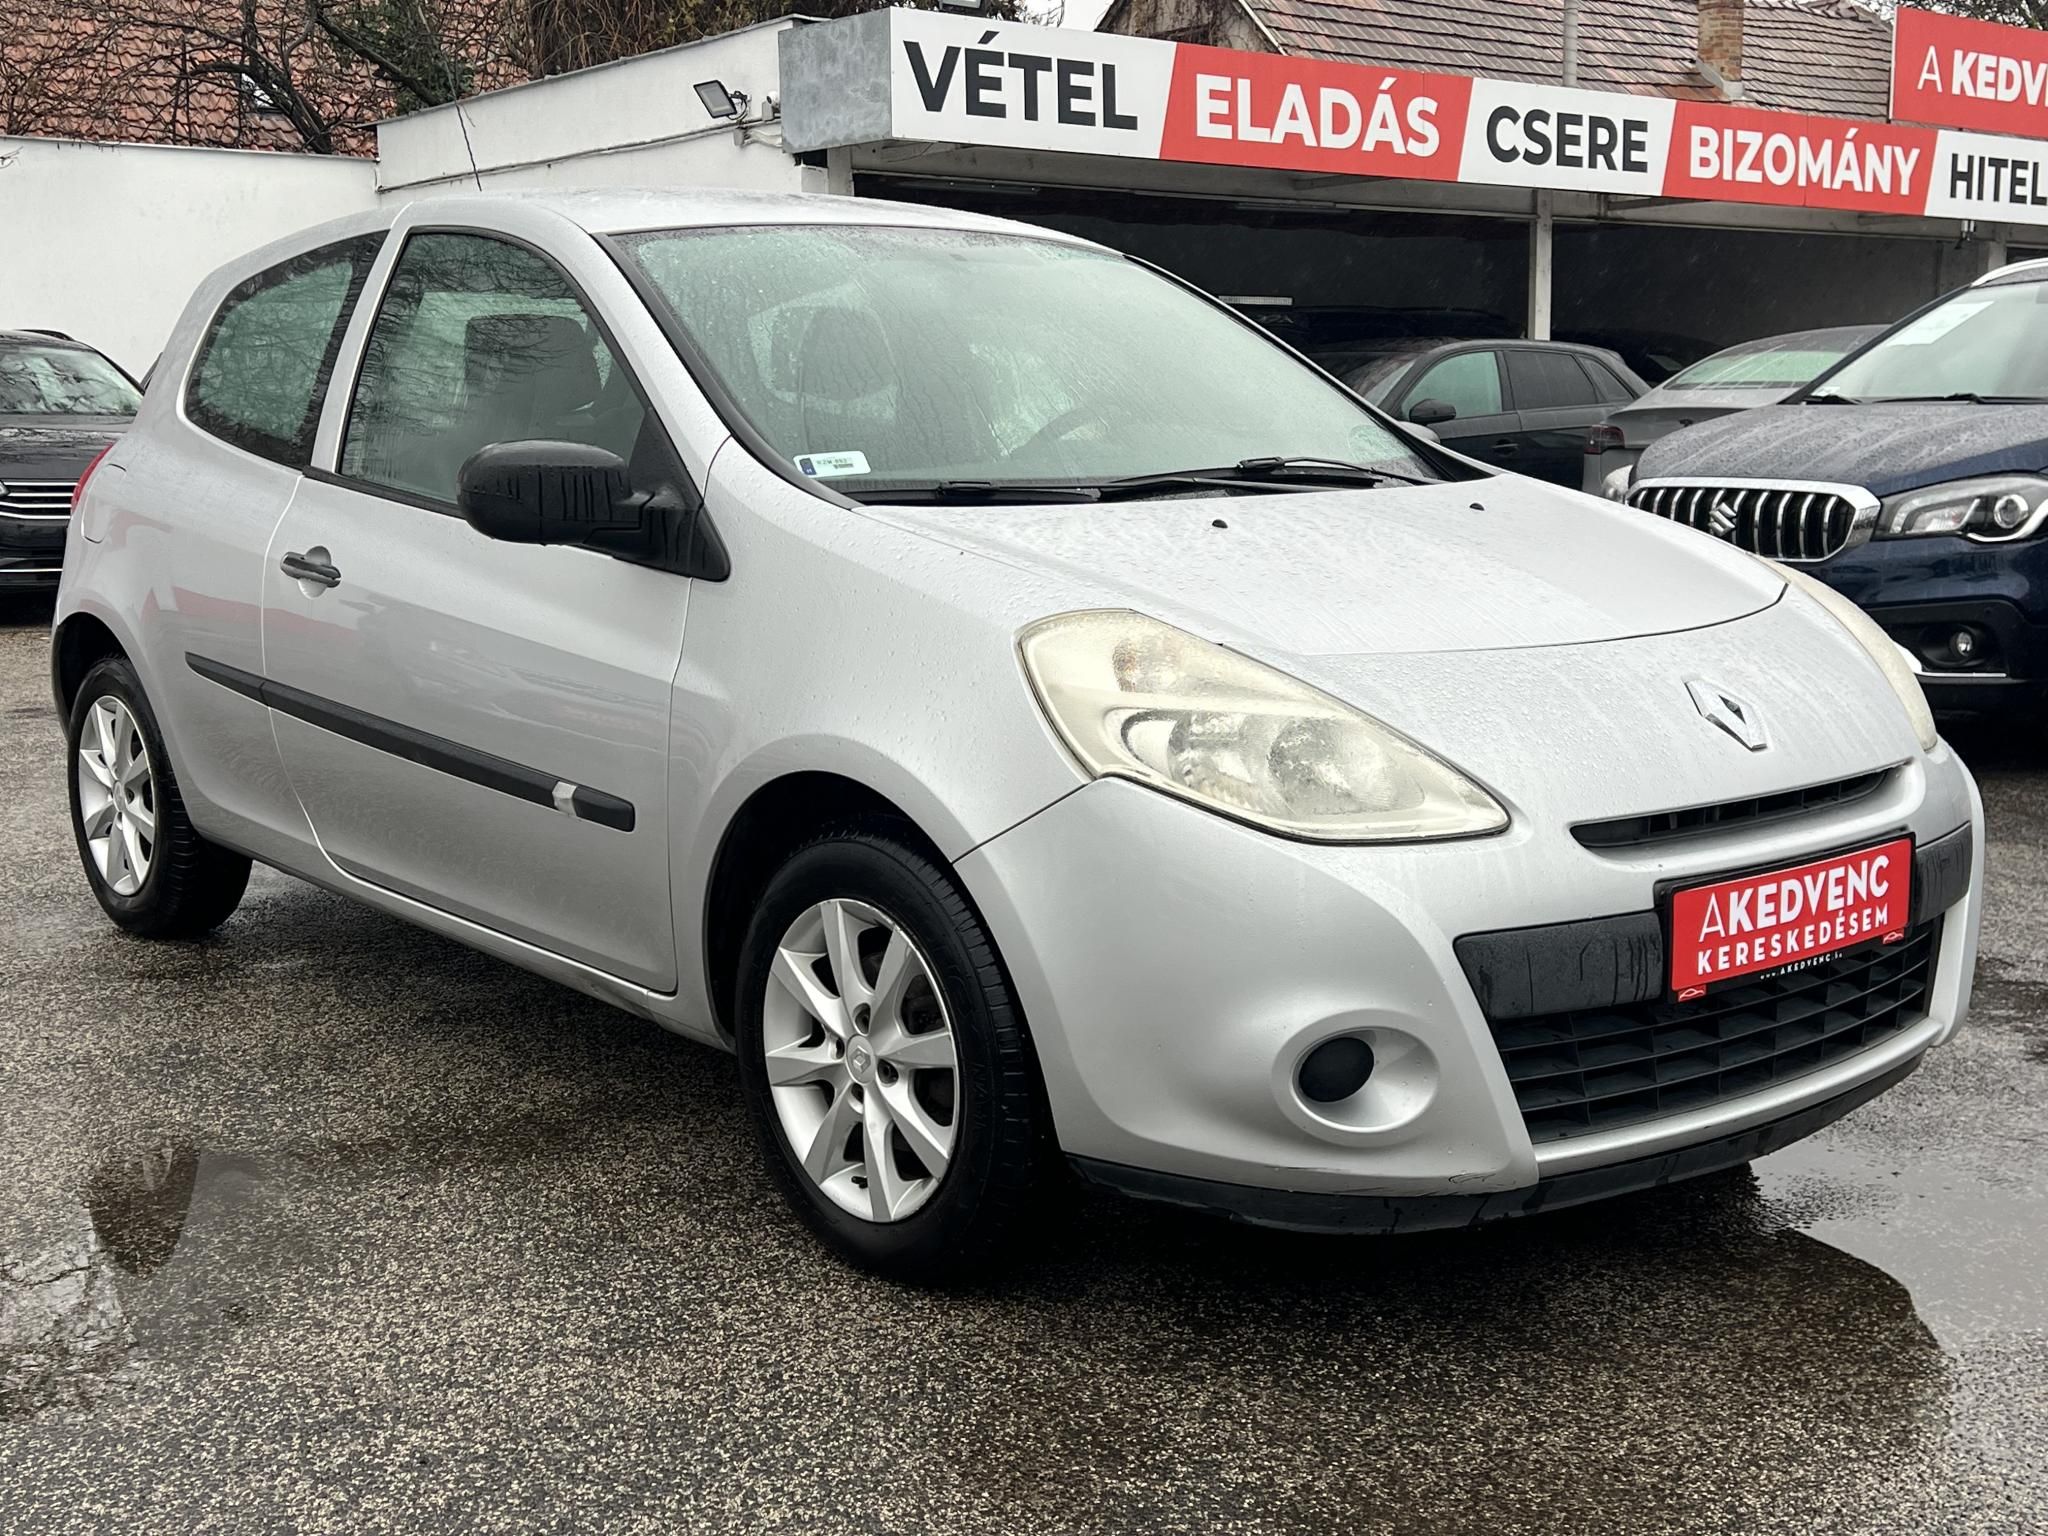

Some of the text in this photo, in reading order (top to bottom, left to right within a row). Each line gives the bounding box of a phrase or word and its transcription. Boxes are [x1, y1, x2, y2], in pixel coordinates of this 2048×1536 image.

[1917, 45, 2048, 108] A KEDV
[903, 31, 2048, 206] VÉTEL ELADÁS CSERE BIZOMÁNY HITEL
[1697, 903, 1888, 976] KERESKEDÉSEM
